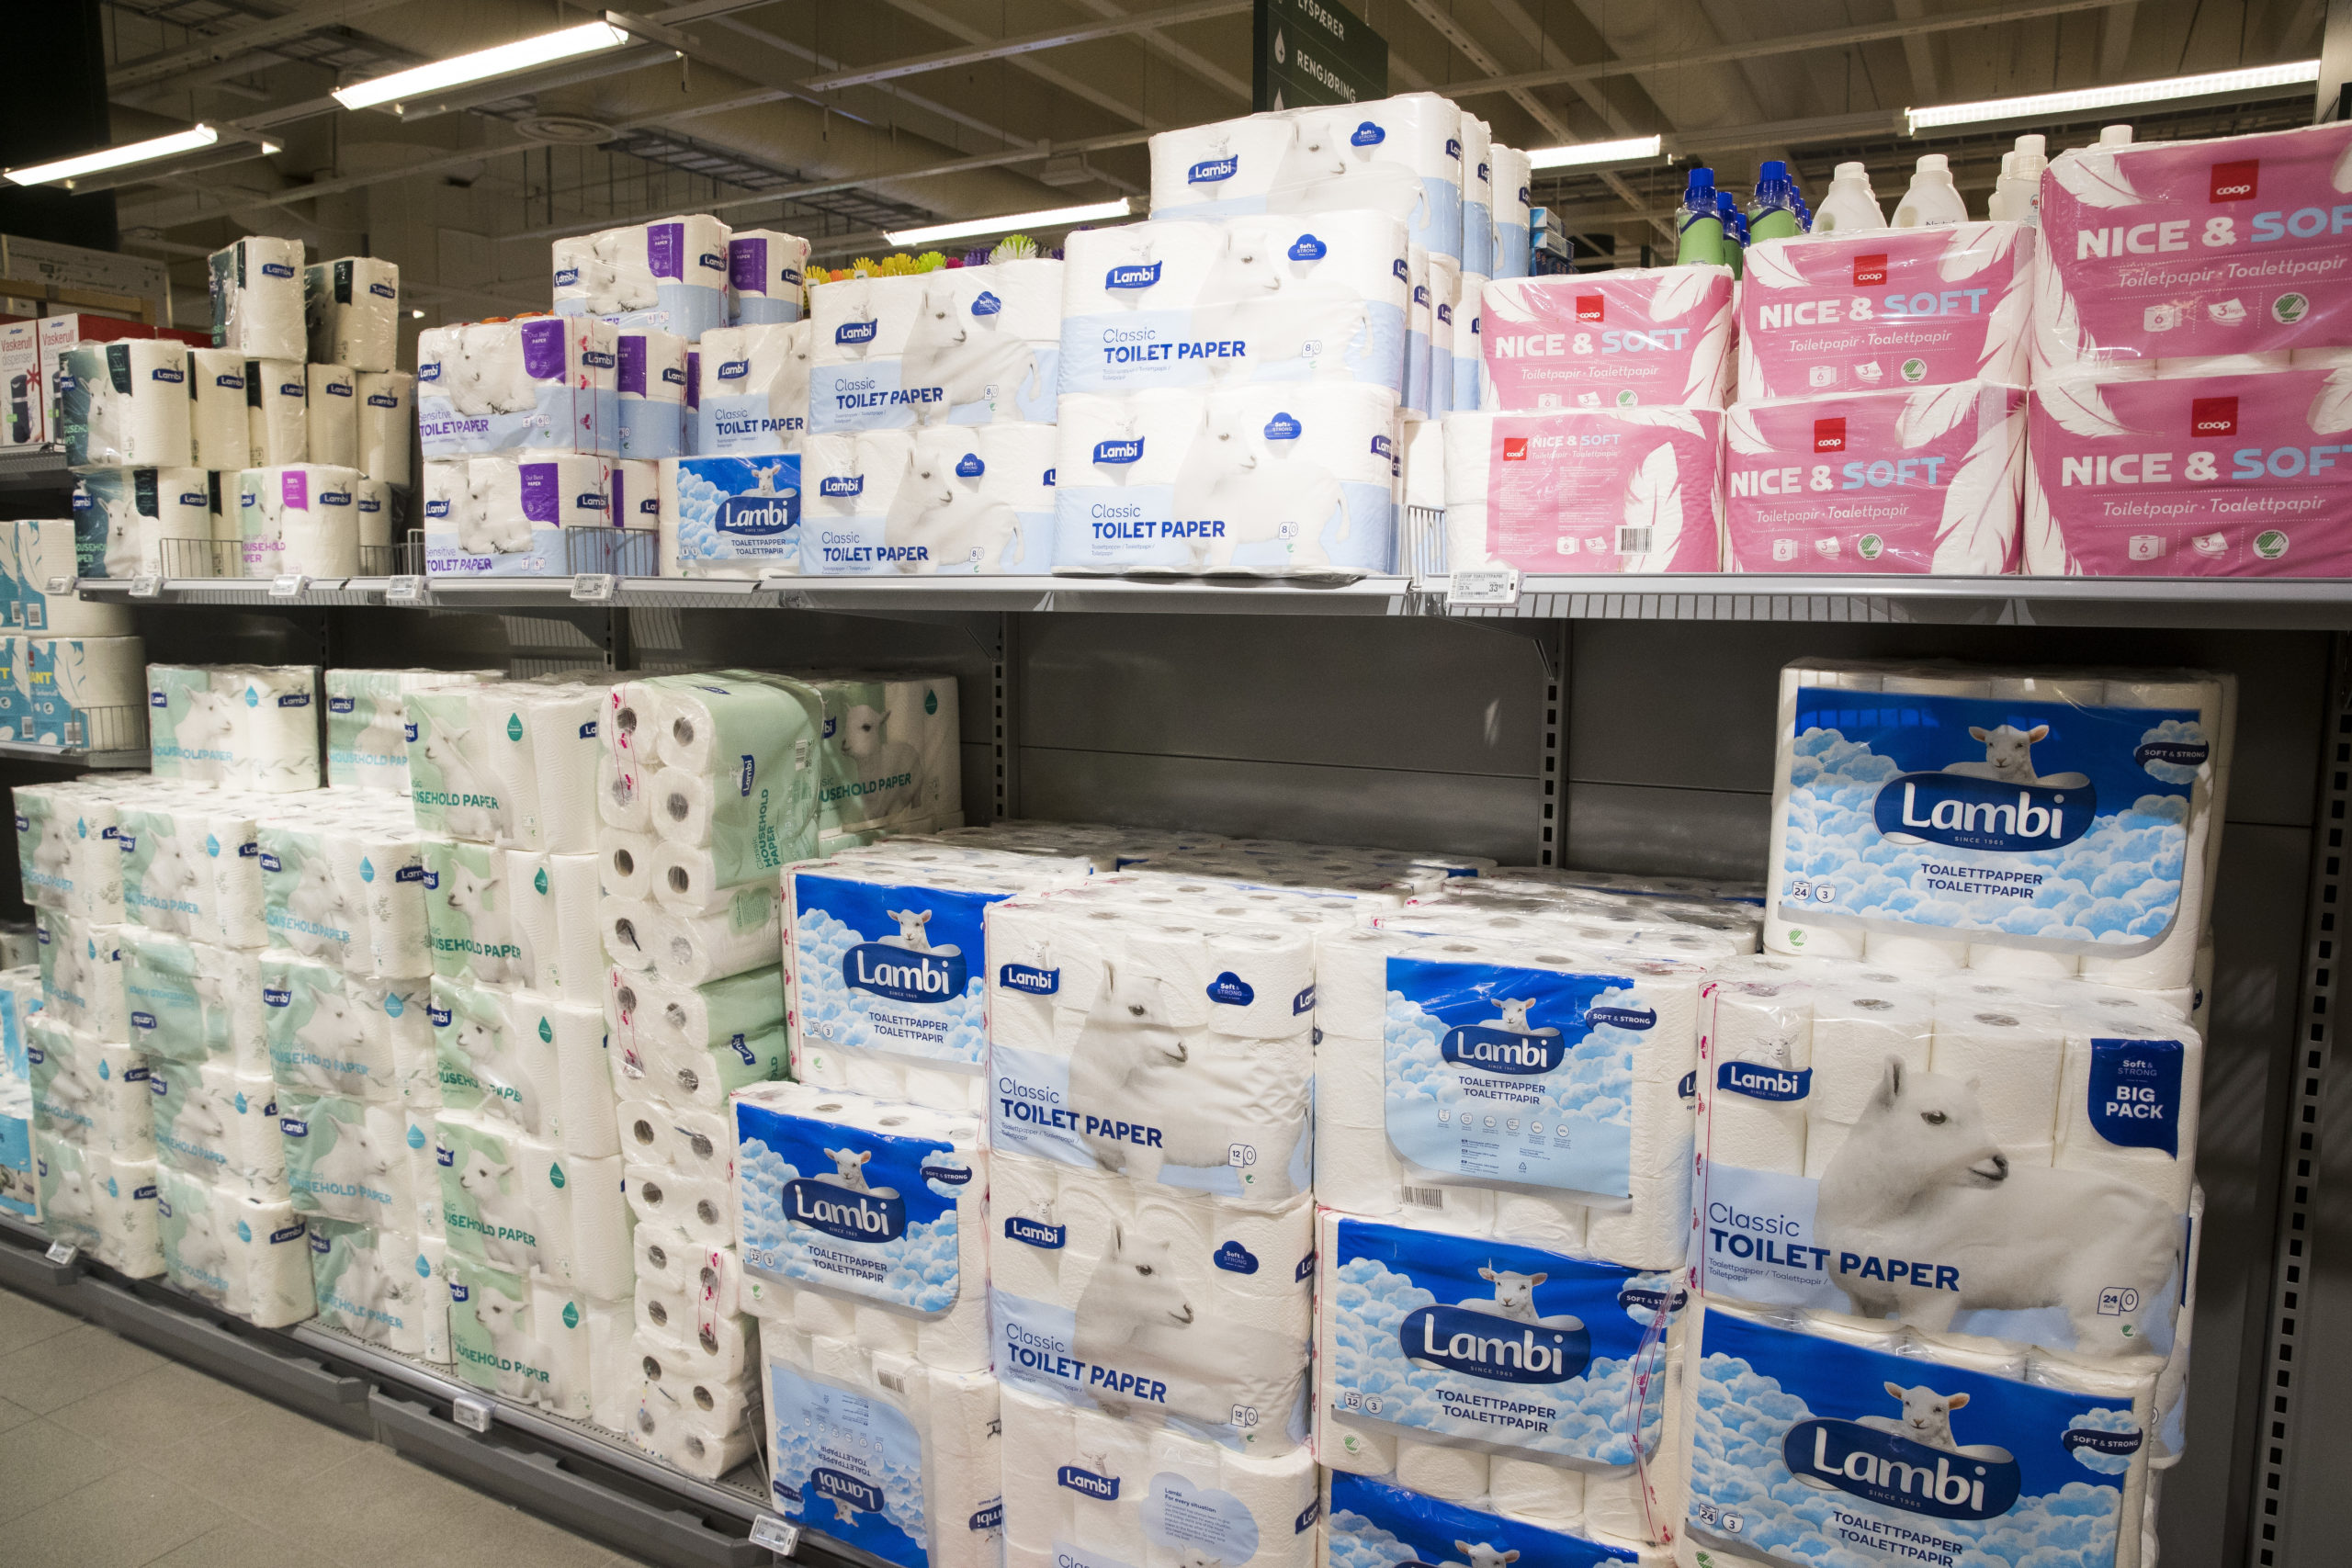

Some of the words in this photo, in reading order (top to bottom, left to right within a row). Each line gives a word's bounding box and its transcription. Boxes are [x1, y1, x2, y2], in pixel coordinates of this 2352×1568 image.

[1298, 0, 1344, 41] LYSPÆRER
[1297, 50, 1356, 103] RENGJØRING
[1194, 162, 1232, 178] Lambi
[2216, 184, 2251, 196] coop
[2076, 219, 2190, 260] NICE
[2201, 216, 2237, 247] &
[2251, 206, 2352, 243] SOF
[267, 265, 293, 276] Lambi
[1114, 267, 1155, 283] Lambi
[1858, 272, 1883, 282] coop
[2118, 268, 2216, 289] Toiletpapir
[2226, 254, 2347, 280] Toalettpapir
[1578, 311, 1600, 320] coop
[1759, 299, 1840, 331] NICE
[1849, 298, 1874, 321] &
[1883, 288, 1988, 320] SOFT
[42, 330, 74, 345] Vaskerull
[841, 324, 872, 340] Lambi
[1102, 326, 1156, 343] Classic
[1, 336, 32, 352] Vaskerull
[1495, 333, 1565, 358] NICE
[1572, 333, 1594, 355] &
[1601, 328, 1690, 354] SOFT
[1790, 336, 1860, 353] Toiletpapir
[1867, 331, 1952, 347] Toalettpapir
[587, 354, 613, 367] Lambi
[1103, 344, 1173, 364] TOILET
[1178, 341, 1246, 359] PAPER
[157, 370, 182, 381] Lambi
[420, 363, 439, 378] Lambi
[722, 364, 744, 375] Lambi
[1521, 367, 1581, 381] Toiletpapir
[1588, 366, 1659, 378] Toalettpapir
[220, 376, 243, 388] Lambi
[331, 384, 351, 395] Lambi
[835, 378, 876, 390] Classic
[373, 396, 395, 407] Lambi
[836, 391, 888, 409] TOILET
[890, 387, 943, 404] PAPER
[715, 408, 748, 419] Classic
[420, 422, 457, 436] TOILET
[458, 419, 489, 434] PAPER
[716, 419, 758, 434] TOILET
[762, 417, 804, 431] PAPER
[2198, 419, 2231, 432] coop
[1532, 435, 1564, 448] NICE
[1566, 434, 1577, 446] &
[1580, 434, 1621, 446] SOFT
[1818, 437, 1841, 447] coop
[1100, 443, 1138, 459] Lambi
[2062, 452, 2172, 487] NICE
[2184, 450, 2219, 481] &
[826, 479, 858, 492] Lambi
[1730, 467, 1802, 498] NICE
[1810, 465, 1834, 491] &
[1842, 457, 1945, 490] SOFT
[184, 494, 207, 504] Lambi
[324, 493, 349, 504] Lambi
[426, 500, 447, 514] Lambi
[582, 494, 607, 506] Lambi
[2103, 501, 2197, 517] Toiletpapir
[2210, 495, 2325, 513] Toalettpapir
[726, 500, 788, 527] Lambi
[1091, 503, 1141, 518] Classic
[1756, 508, 1820, 524] Toiletpapir
[1827, 504, 1909, 520] Toalettpapir
[1092, 521, 1157, 538] TOILET
[1161, 520, 1225, 537] PAPER
[731, 537, 786, 547] TOALETTPAPPER
[821, 532, 860, 544] Classic
[2200, 536, 2210, 549] 3
[426, 546, 456, 558] Sensitive
[735, 547, 783, 555] TOALETTPAPIR
[823, 547, 872, 562] TOILET
[876, 546, 929, 561] PAPER
[2139, 542, 2148, 555] 6
[426, 558, 458, 571] TOILET
[459, 558, 492, 570] PAPER
[283, 695, 307, 705] Lambi
[2144, 749, 2166, 758] SOFT
[2177, 750, 2205, 759] STRONG
[741, 759, 752, 793] Lambi
[878, 773, 911, 791] PAPER
[463, 795, 499, 809] PAPER
[1901, 782, 2066, 840] Lambi
[759, 788, 772, 868] HOUSEHOLD
[766, 825, 780, 865] PAPER
[1954, 836, 1981, 845] SINCE
[1984, 838, 2004, 846] 1965
[755, 836, 764, 870] Classic
[1921, 863, 2043, 886] TOALETTPAPPER
[1793, 887, 1808, 898] 24
[1927, 878, 2035, 899] TOALETTPAPIR
[484, 943, 522, 960] PAPER
[856, 950, 950, 995] Lambi
[1008, 967, 1052, 989] Lambi
[868, 1011, 948, 1032] TOALETTPAPPER
[1593, 1013, 1611, 1021] SOFT
[1620, 1016, 1650, 1025] STRONG
[874, 1025, 944, 1043] TOALETTPAPIR
[1456, 1031, 1548, 1068] Lambi
[2117, 1067, 2157, 1077] STRONG
[2122, 1059, 2146, 1068] Soft
[1458, 1076, 1546, 1094] TOALETTPAPPER
[1730, 1066, 1799, 1095] Lambi
[999, 1077, 1059, 1104] Classic
[1464, 1088, 1540, 1105] TOALETTPAPIR
[2116, 1086, 2155, 1103] BIG
[2106, 1101, 2164, 1120] PACK
[1001, 1098, 1080, 1132] TOILET
[1086, 1115, 1163, 1148] PAPER
[794, 1184, 889, 1235] Lambi
[1709, 1202, 1801, 1236] Classic
[498, 1226, 537, 1247] PAPER
[1012, 1221, 1058, 1244] Lambi
[808, 1245, 888, 1272] TOALETTPAPPER
[1224, 1256, 1247, 1265] STRONG
[1226, 1250, 1239, 1258] Soft
[1709, 1228, 1831, 1271] TOILET
[1839, 1253, 1960, 1292] PAPER
[812, 1258, 884, 1283] TOALETTPAPIR
[1708, 1258, 1764, 1278] Toalettpapper
[1772, 1271, 1822, 1286] Toalettpapir
[1708, 1267, 1749, 1284] Toiletpapir
[1626, 1294, 1645, 1303] SOFT
[2103, 1294, 2118, 1305] 24
[1006, 1323, 1065, 1353] Classic
[1423, 1314, 1564, 1376] Lambi
[514, 1361, 549, 1383] PAPER
[1007, 1343, 1085, 1381] TOILET
[1090, 1365, 1167, 1404] PAPER
[1470, 1366, 1494, 1375] SINCE
[1347, 1397, 1358, 1406] 12
[1371, 1402, 1377, 1411] 3
[1435, 1389, 1556, 1420] TOALETTPAPPER
[1442, 1404, 1548, 1433] TOALETTPAPIR
[2073, 1436, 2098, 1447] SOFT
[2107, 1439, 2139, 1450] STRONG
[818, 1452, 871, 1477] TOALETTPAPPER
[820, 1445, 867, 1467] TOALETTPAPIR
[1813, 1426, 1985, 1513] Lambi
[819, 1471, 876, 1509] Lambi
[1067, 1469, 1112, 1495] Lambi
[1165, 1488, 1182, 1497] Lambi
[1868, 1489, 1896, 1501] SINCE
[1899, 1498, 1922, 1508] 1965
[1175, 1498, 1189, 1506] every
[1191, 1502, 1216, 1513] situation
[1701, 1509, 1714, 1523] 24
[1833, 1510, 1963, 1555] TOALETTPAPPER
[1838, 1529, 1954, 1568] TOALETTPAPIR
